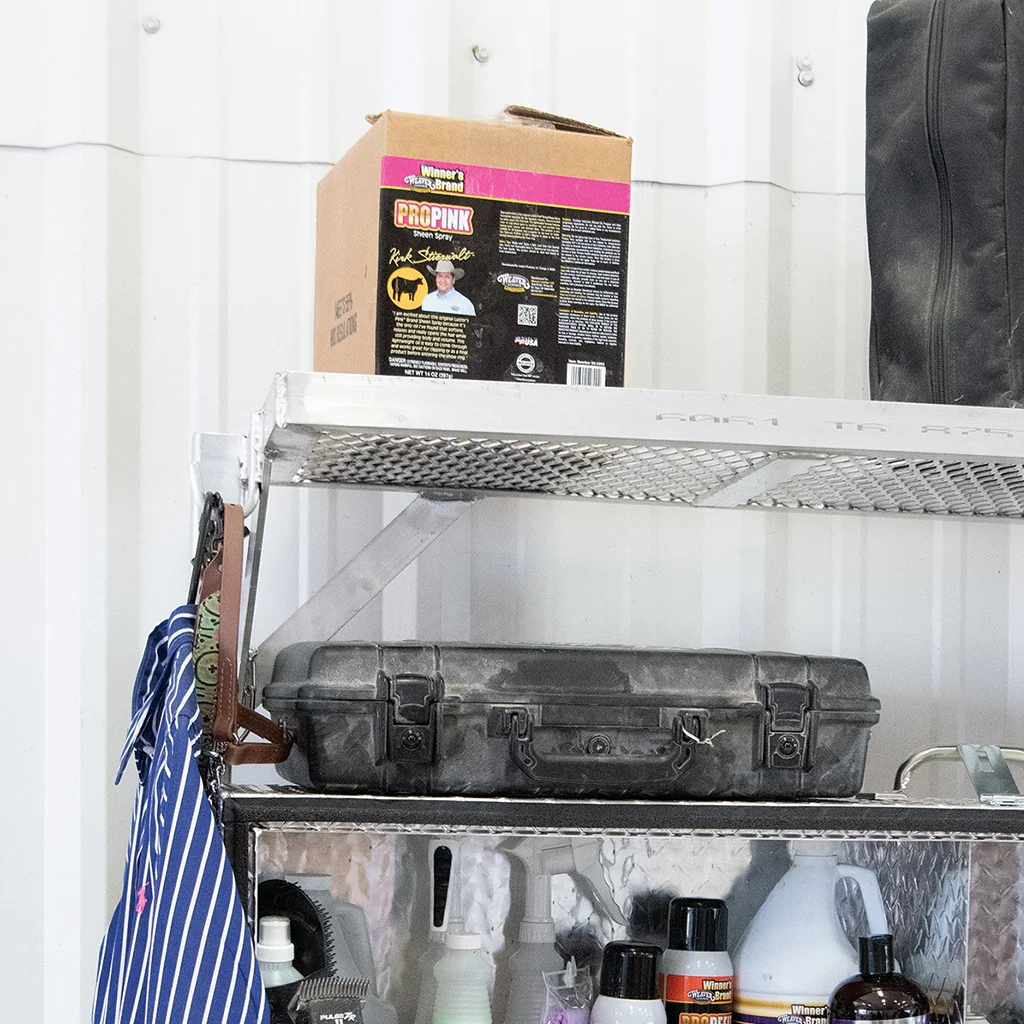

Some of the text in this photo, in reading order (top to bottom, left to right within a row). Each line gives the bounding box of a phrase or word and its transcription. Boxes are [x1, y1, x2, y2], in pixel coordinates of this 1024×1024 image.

[420, 164, 464, 181] Winner's
[434, 178, 464, 193] Brand
[396, 202, 471, 232] PROPINK
[434, 232, 454, 242] Spray
